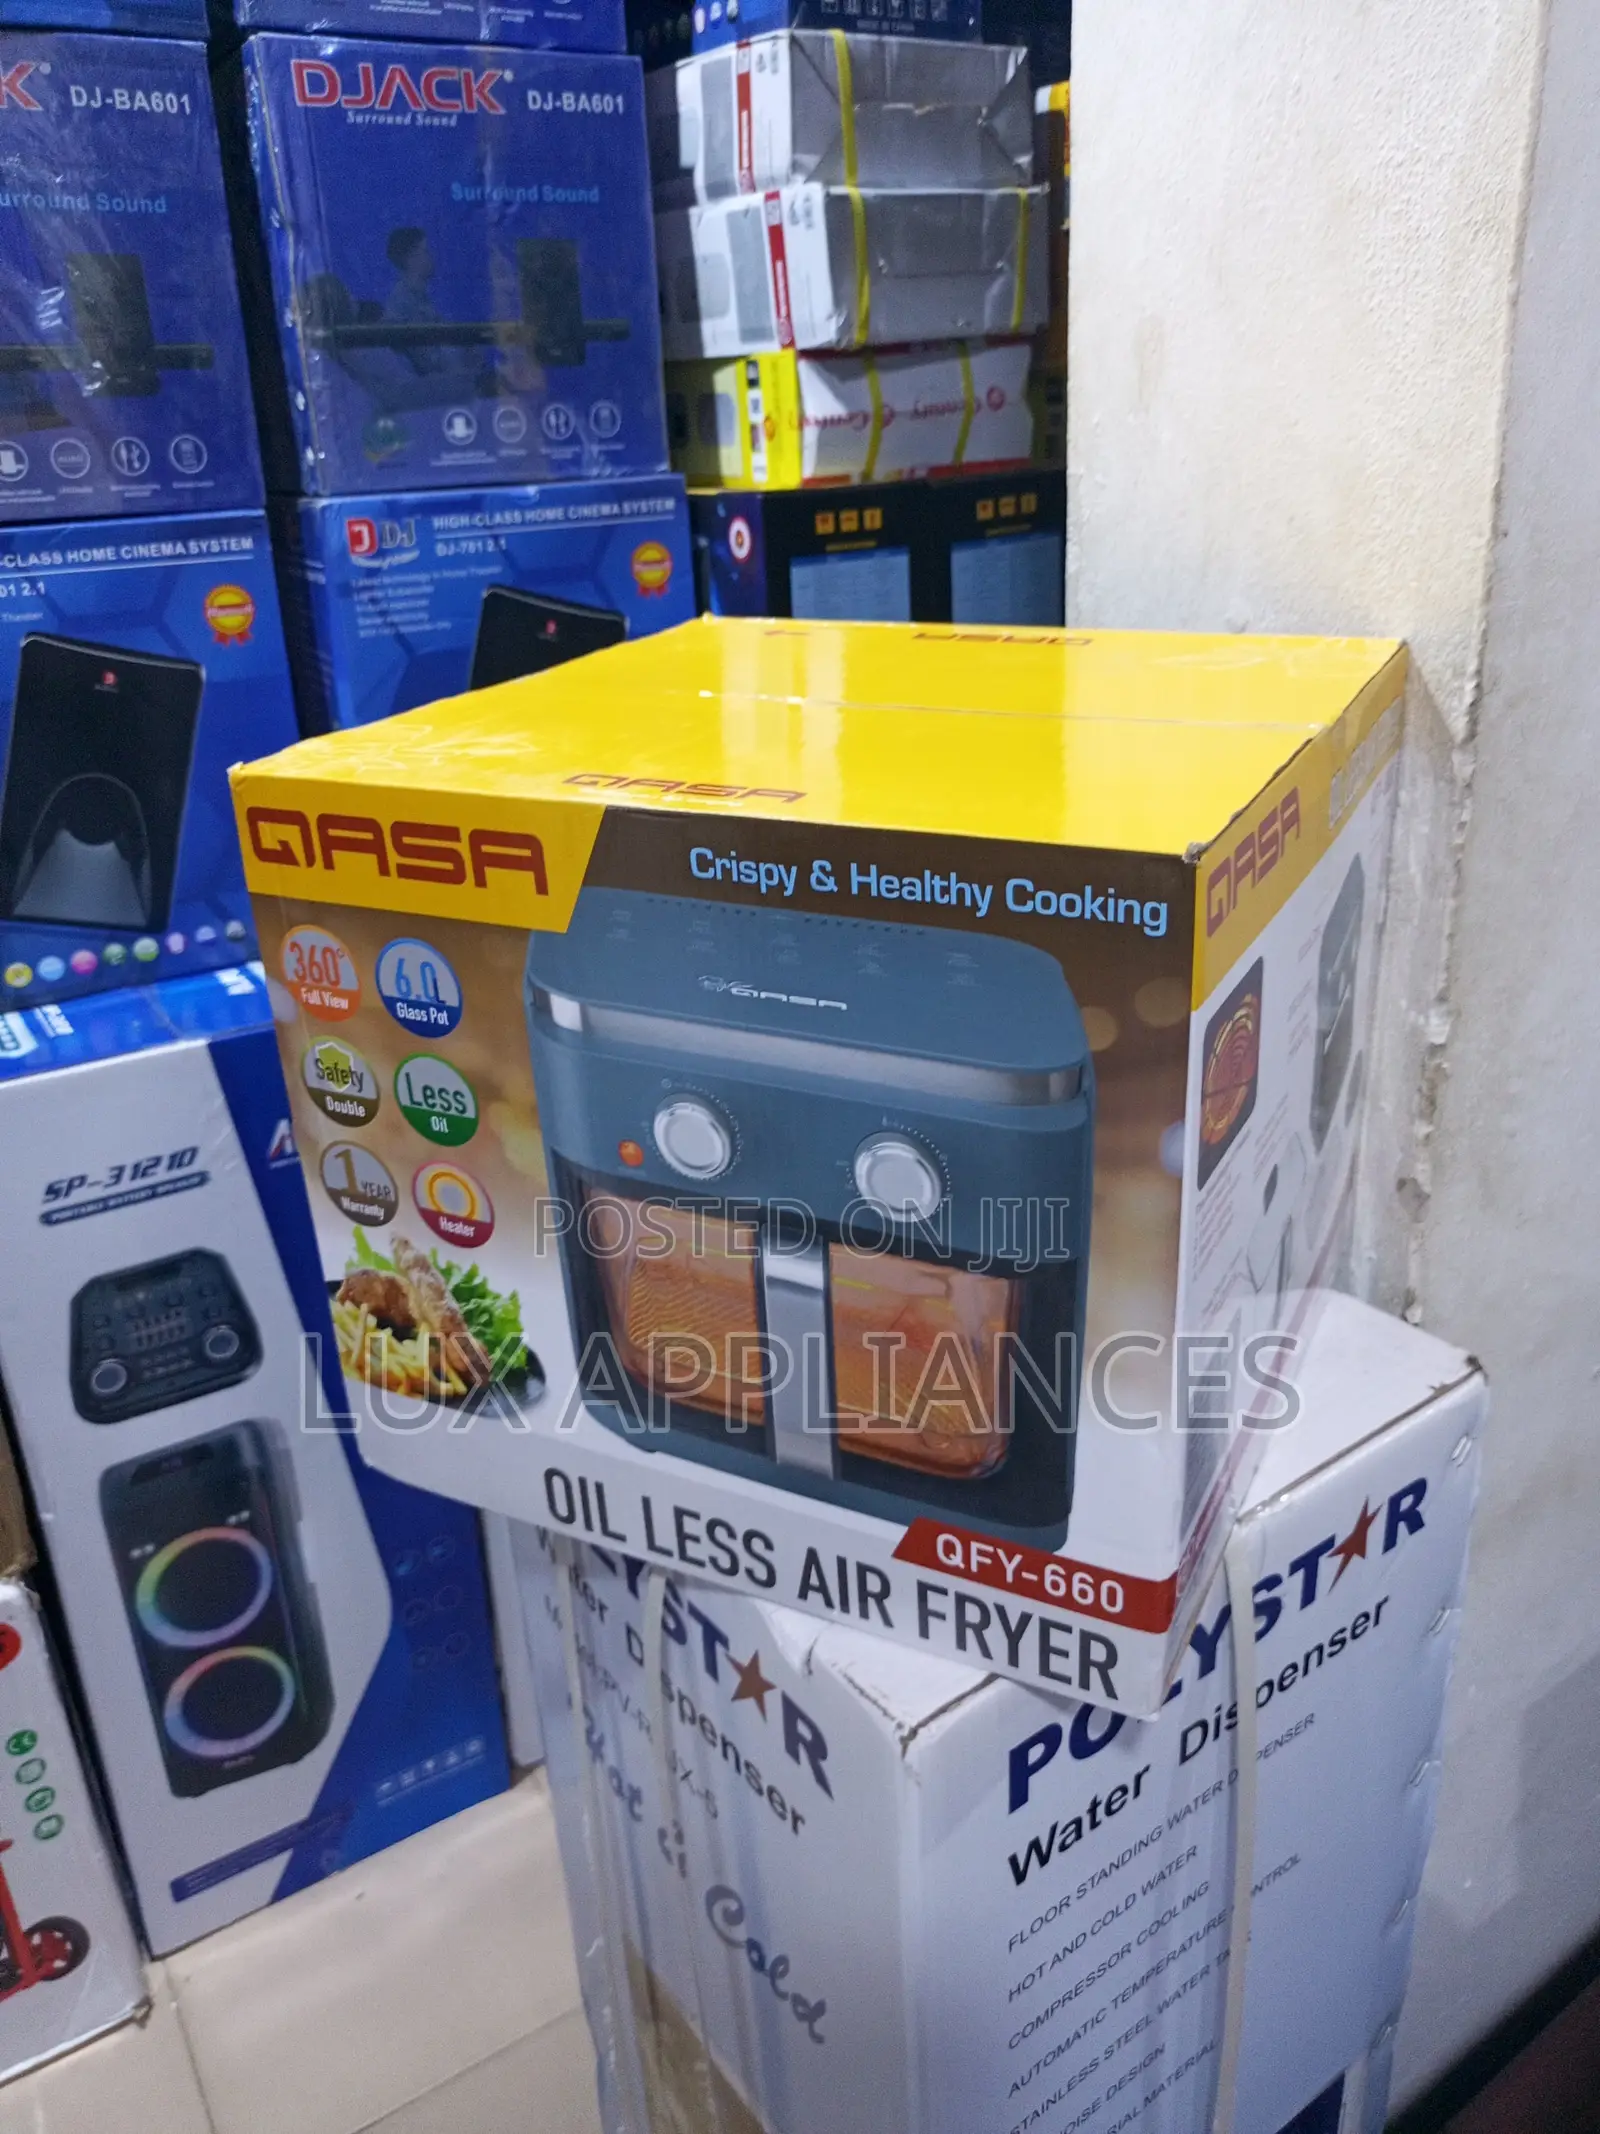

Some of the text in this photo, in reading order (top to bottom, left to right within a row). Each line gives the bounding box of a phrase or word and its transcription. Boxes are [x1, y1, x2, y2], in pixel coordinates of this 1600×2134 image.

[70, 85, 191, 115] DJ-BA601
[290, 59, 625, 115] DJACK DJ-BA601
[96, 191, 168, 214] Sound
[543, 184, 600, 204] Sound
[433, 510, 522, 530] HIGH-CLASS
[525, 506, 565, 524] HOME
[567, 502, 620, 521] CINEMA
[621, 498, 676, 516] SYSTEM
[67, 547, 117, 563] HOME
[121, 541, 185, 560] CINEMA
[188, 536, 254, 555] SYSTEM
[20, 581, 46, 597] 2.1
[563, 773, 808, 804] QASA
[247, 806, 549, 896] QASA
[1206, 785, 1301, 938] QASA
[689, 846, 1169, 938] Crispy & Healthy Cooking
[300, 987, 349, 1011] Full View
[396, 1002, 450, 1026] Glass Pot
[315, 1057, 364, 1093] Safety
[405, 1072, 468, 1115] Less
[325, 1095, 366, 1118] Double
[430, 1116, 449, 1133] Oil
[334, 1149, 394, 1201] 1 YEAR
[341, 1196, 384, 1220] Warranty
[438, 1216, 476, 1238] Heater
[543, 1467, 1120, 1700] OIL LESS AIR FRYER
[935, 1532, 1125, 1616] QFY-660
[625, 1621, 806, 1835] Dspenser
[1007, 1763, 1151, 1887] Water
[1008, 1894, 1072, 1953] FLOOR
[1075, 1824, 1164, 1901] STANDING
[1166, 1779, 1224, 1832] WATER
[1008, 1845, 1198, 2003] HOT AND COLD WATER
[1008, 1880, 1210, 2050] COMPRESSOR COOLING
[1008, 2007, 1108, 2098] AUTOMATIC
[1111, 1910, 1227, 2010] TEMPERATURE
[1103, 2013, 1155, 2062] STEEL
[1156, 1963, 1211, 2016] WATER
[1106, 2041, 1166, 2101] DESIGN
[1143, 2039, 1216, 2104] MATERIAL
